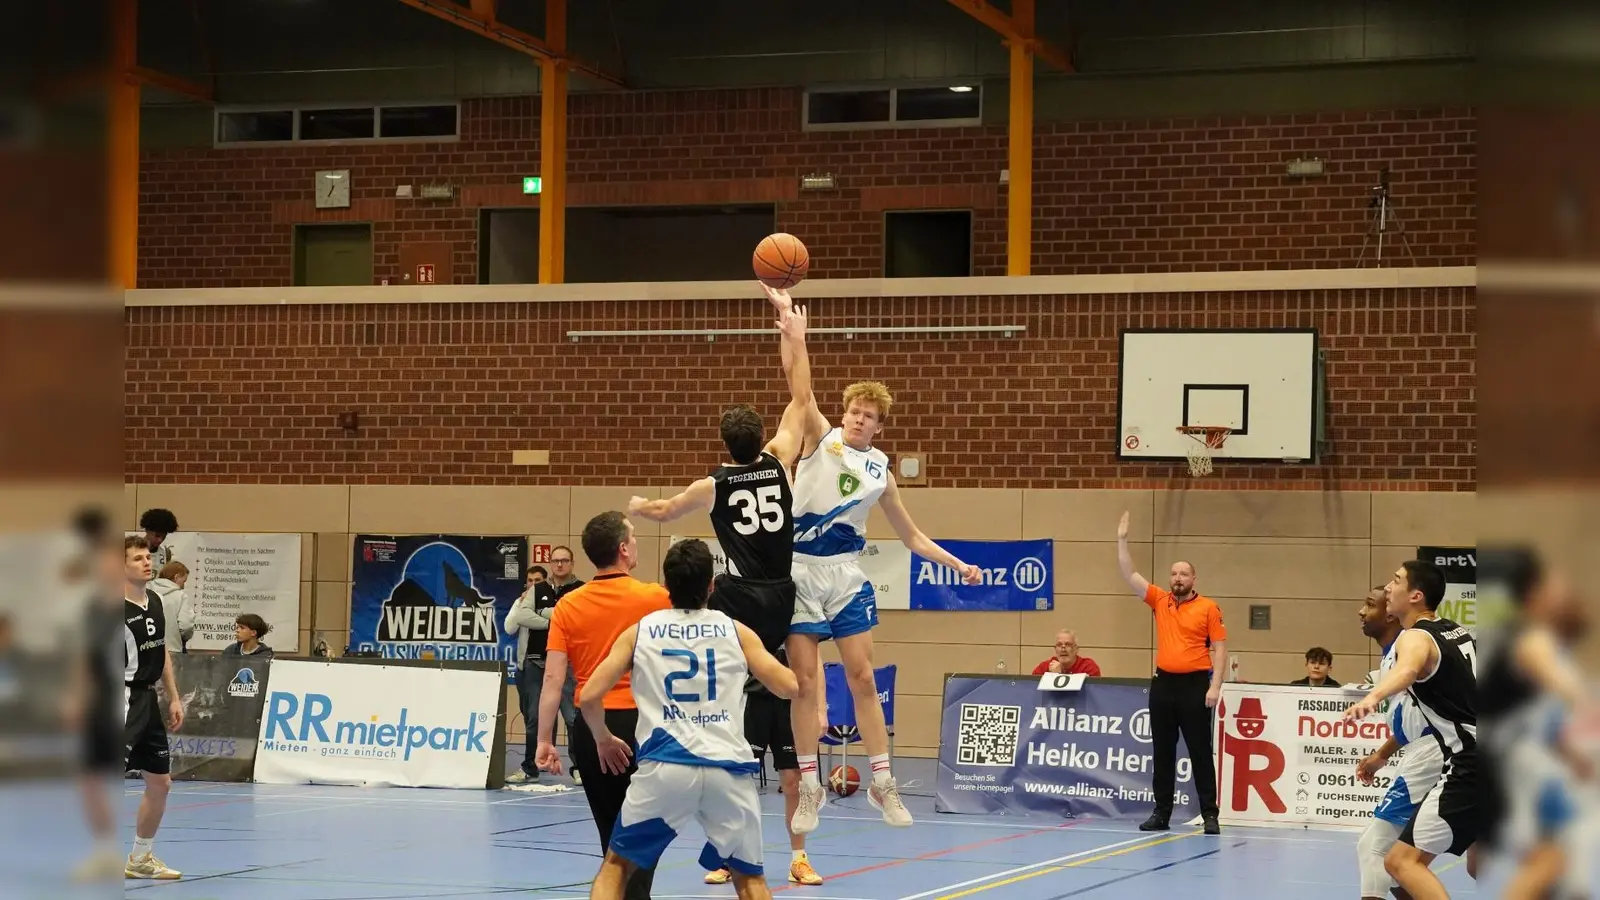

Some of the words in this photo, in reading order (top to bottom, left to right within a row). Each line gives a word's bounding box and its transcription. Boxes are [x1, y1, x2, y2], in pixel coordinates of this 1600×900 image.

[727, 469, 779, 485] TEGERNHEIM
[865, 459, 882, 480] 16
[728, 484, 785, 535] 35
[916, 561, 1008, 586] Allinz
[145, 617, 157, 636] 6
[385, 605, 494, 641] WEIDEN
[648, 623, 728, 640] WEIDEN
[661, 648, 717, 703] 21
[230, 682, 259, 693] WEIDEN
[1029, 706, 1123, 735] Allianz
[264, 740, 308, 752] Mieten
[321, 746, 349, 756] ganz
[354, 747, 396, 758] einfach
[1304, 745, 1346, 755] MALER-
[1350, 747, 1358, 756] &
[1027, 741, 1100, 769] Heiko
[1105, 746, 1193, 782] Herg
[954, 772, 985, 781] Besuchen
[977, 784, 1015, 794] Homepage!
